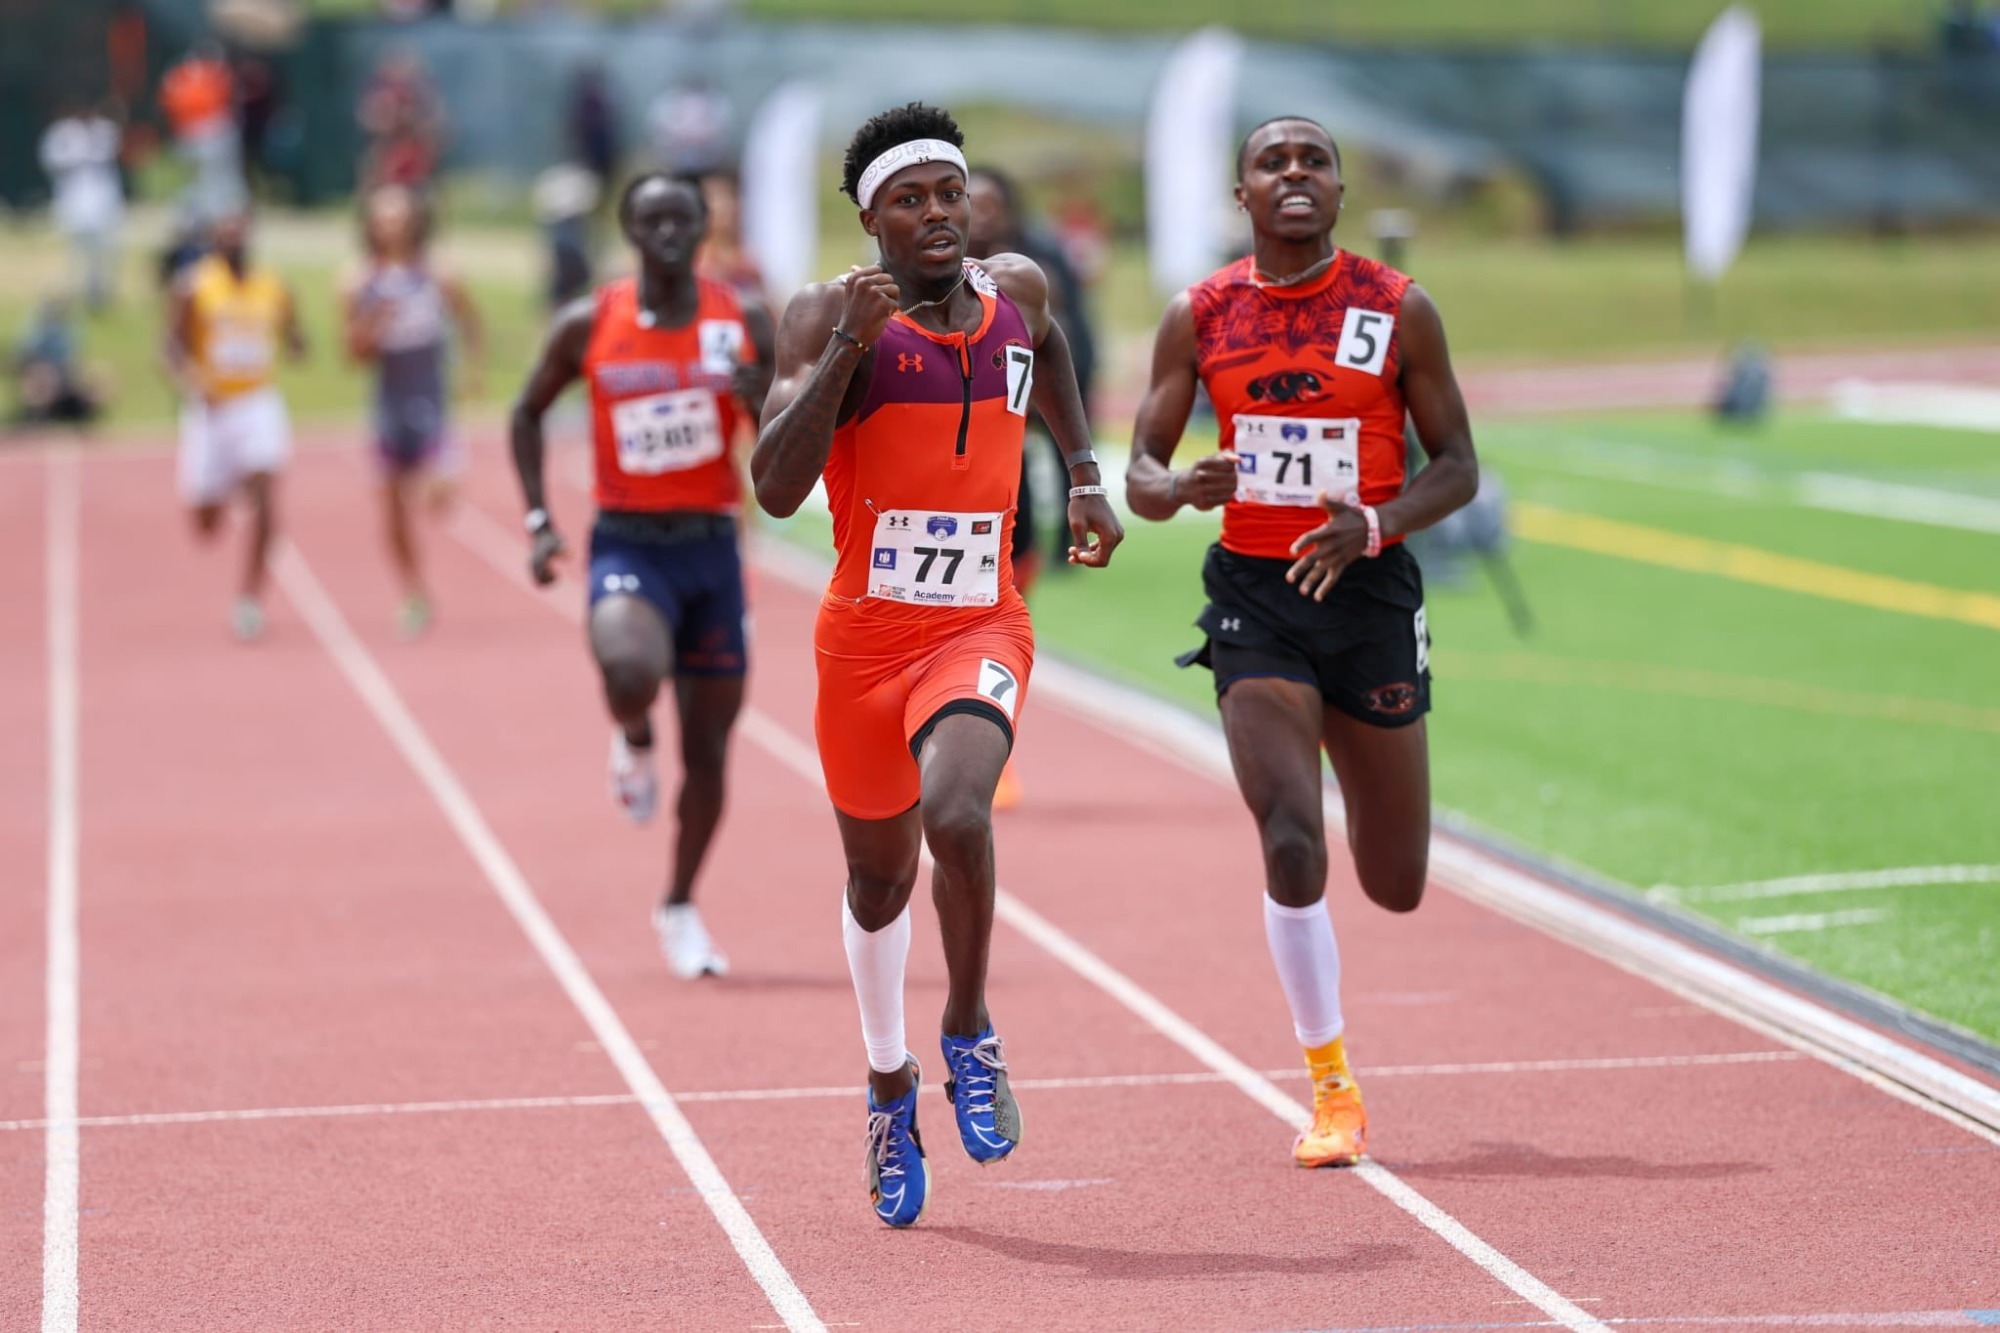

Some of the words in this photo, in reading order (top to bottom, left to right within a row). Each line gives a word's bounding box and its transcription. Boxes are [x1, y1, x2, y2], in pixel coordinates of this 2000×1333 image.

[1348, 314, 1382, 365] 5
[1011, 351, 1032, 409] 7
[1271, 451, 1312, 486] 71
[913, 546, 965, 585] 77
[913, 590, 955, 604] Academy
[987, 662, 1015, 701] 7
